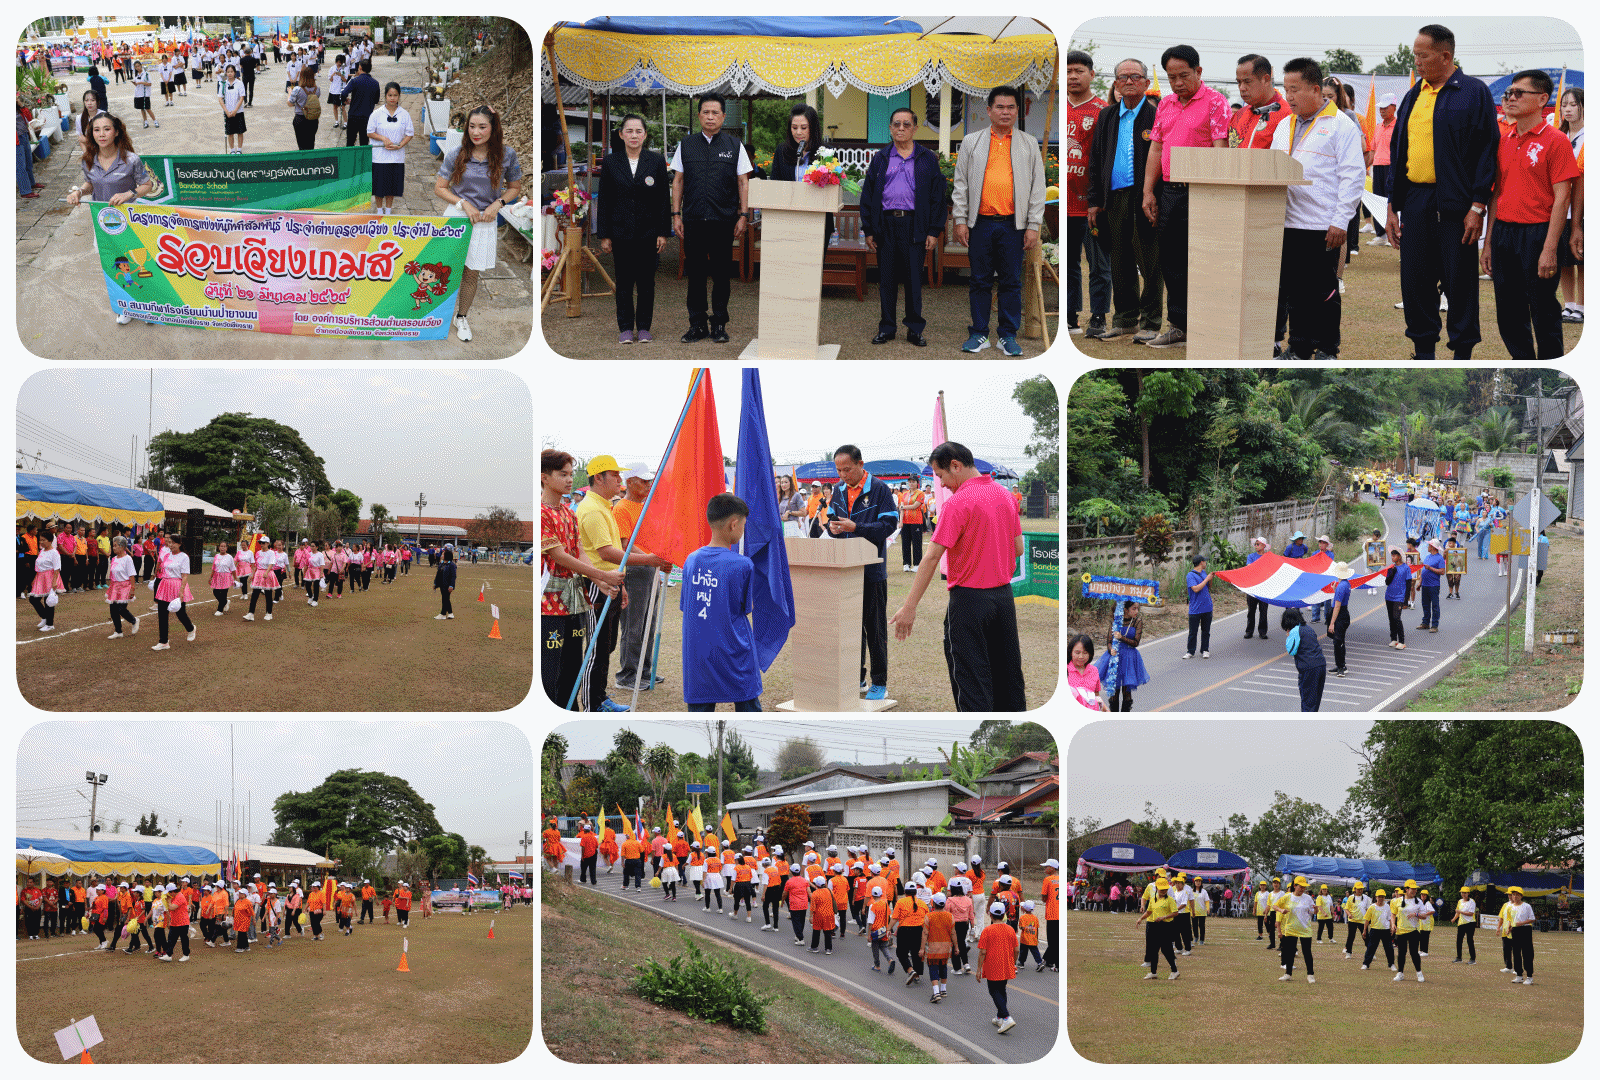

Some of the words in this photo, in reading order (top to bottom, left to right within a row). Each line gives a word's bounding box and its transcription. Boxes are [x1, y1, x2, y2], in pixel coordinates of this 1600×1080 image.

[176, 167, 236, 181] โรงเรียนบ้านดู่
[178, 181, 204, 190] Bandoo
[206, 181, 229, 190] School
[157, 233, 402, 281] รอบเวียงเกมส์
[204, 281, 233, 298] วันที่
[235, 285, 254, 299] ๒๑
[259, 287, 306, 303] มีนาคม
[294, 312, 309, 322] โดย
[311, 314, 443, 328] องค์การบริหารส่วนตำบลรอบเวียง
[1032, 546, 1059, 560] โรงเรี
[692, 567, 718, 588] ป่างิ้ว
[696, 588, 712, 607] หมู่
[1143, 586, 1152, 596] 4
[698, 607, 708, 619] 4
